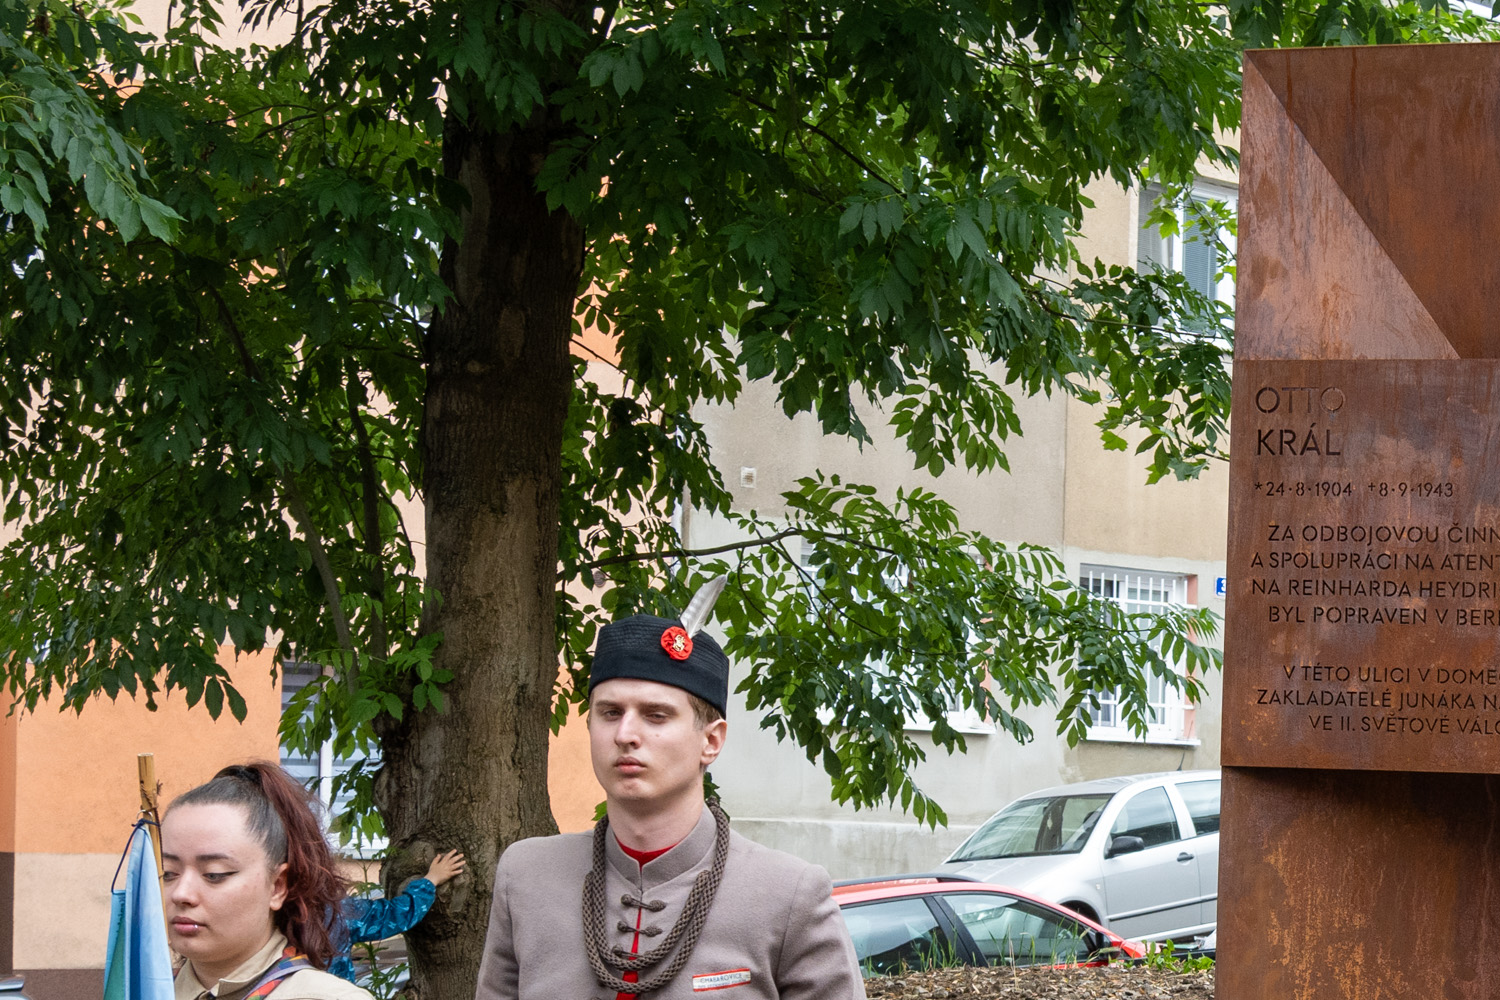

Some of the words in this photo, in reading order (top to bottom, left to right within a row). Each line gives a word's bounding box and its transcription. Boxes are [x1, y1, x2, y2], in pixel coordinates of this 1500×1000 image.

[1256, 386, 1345, 414] OTTO
[1257, 422, 1340, 456] KRÁL
[1268, 525, 1295, 542] ZA
[1302, 525, 1438, 546] ODBOJOVOU
[1250, 552, 1264, 568] A
[1269, 550, 1397, 570] SPOLUPRÁCI
[1405, 554, 1434, 570] NA
[1252, 579, 1281, 596] NA
[1288, 580, 1411, 598] REINHARDA
[1268, 606, 1305, 622] BYL
[1313, 606, 1426, 624] POPRAVEN
[1435, 608, 1449, 624] V
[1283, 665, 1296, 680] V
[1302, 662, 1350, 682] TÉTO
[1358, 666, 1410, 683] ULICI
[1418, 668, 1430, 682] V
[1256, 688, 1392, 707] ZAKLADATELÉ
[1397, 690, 1476, 711] JUNÁKA
[1308, 715, 1332, 731] VE
[1341, 716, 1355, 732] II.
[1362, 713, 1450, 734] SVĚTOVÉ
